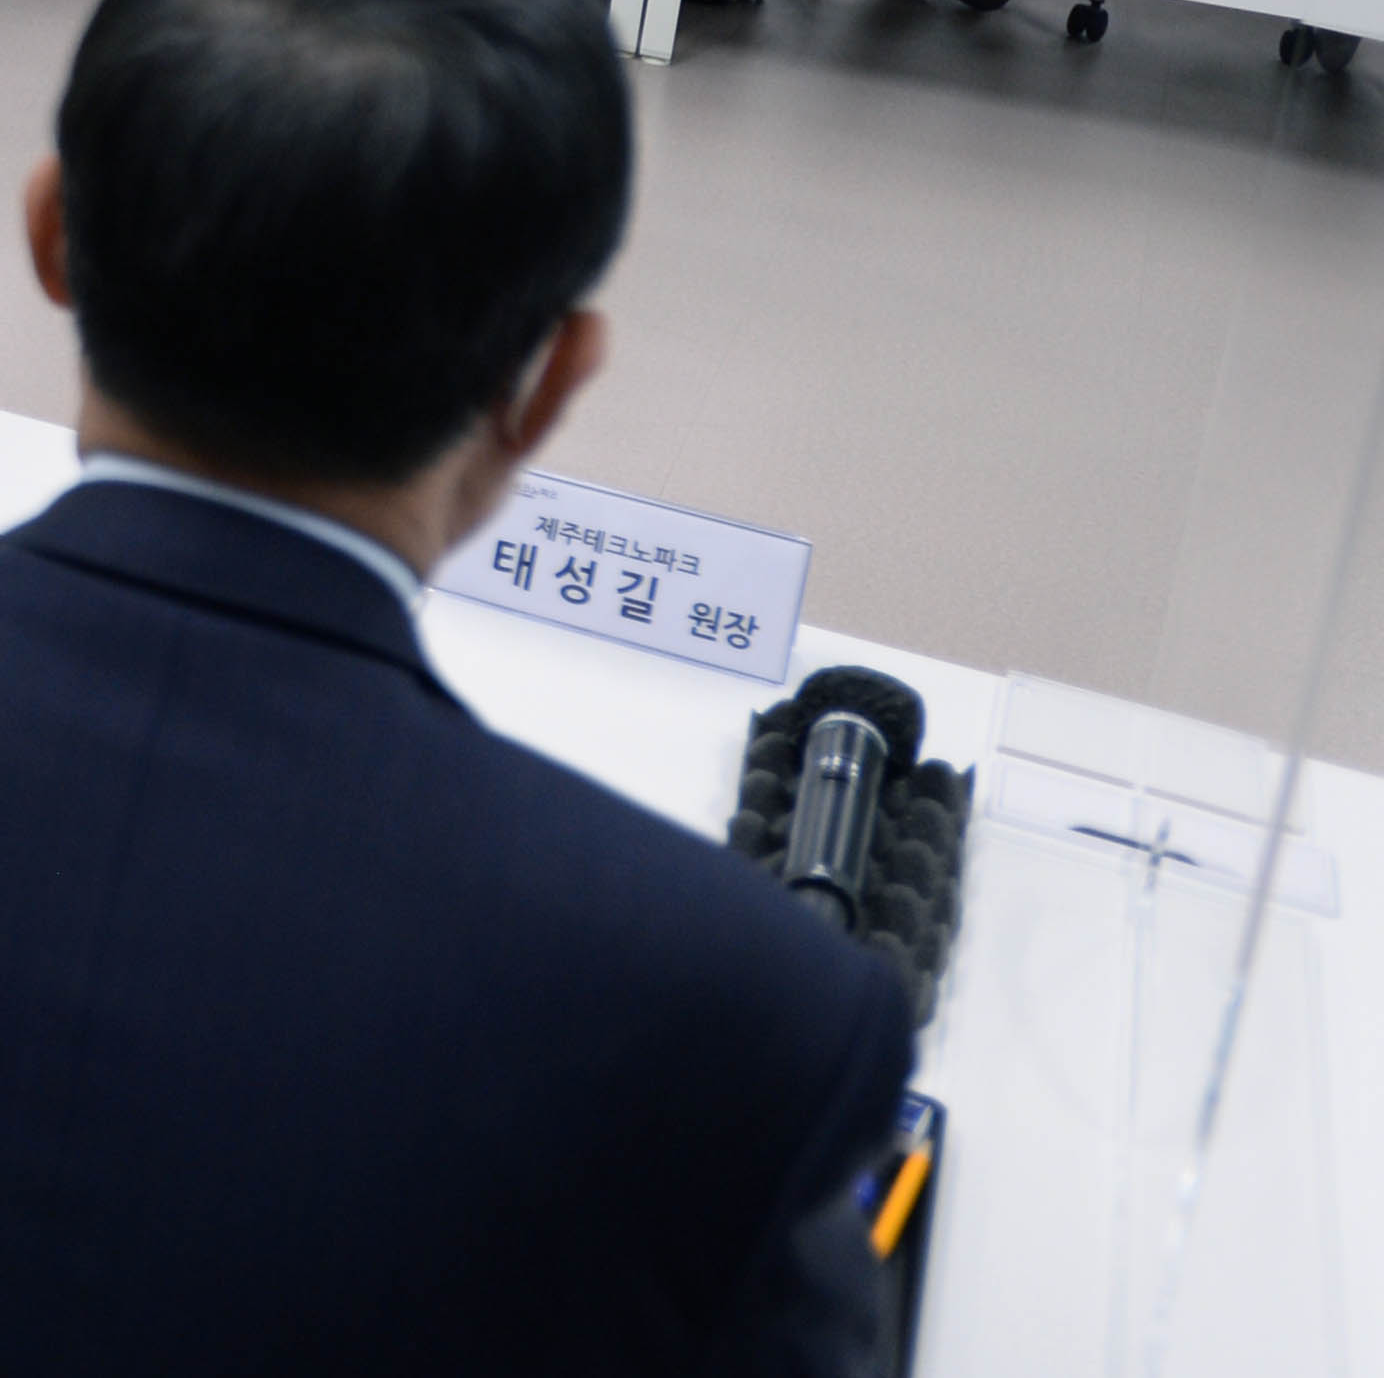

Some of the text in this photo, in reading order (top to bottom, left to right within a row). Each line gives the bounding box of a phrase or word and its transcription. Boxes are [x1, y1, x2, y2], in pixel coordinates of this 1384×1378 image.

[535, 515, 702, 577] 제주테크노파크
[491, 538, 761, 651] 태성길 원장
